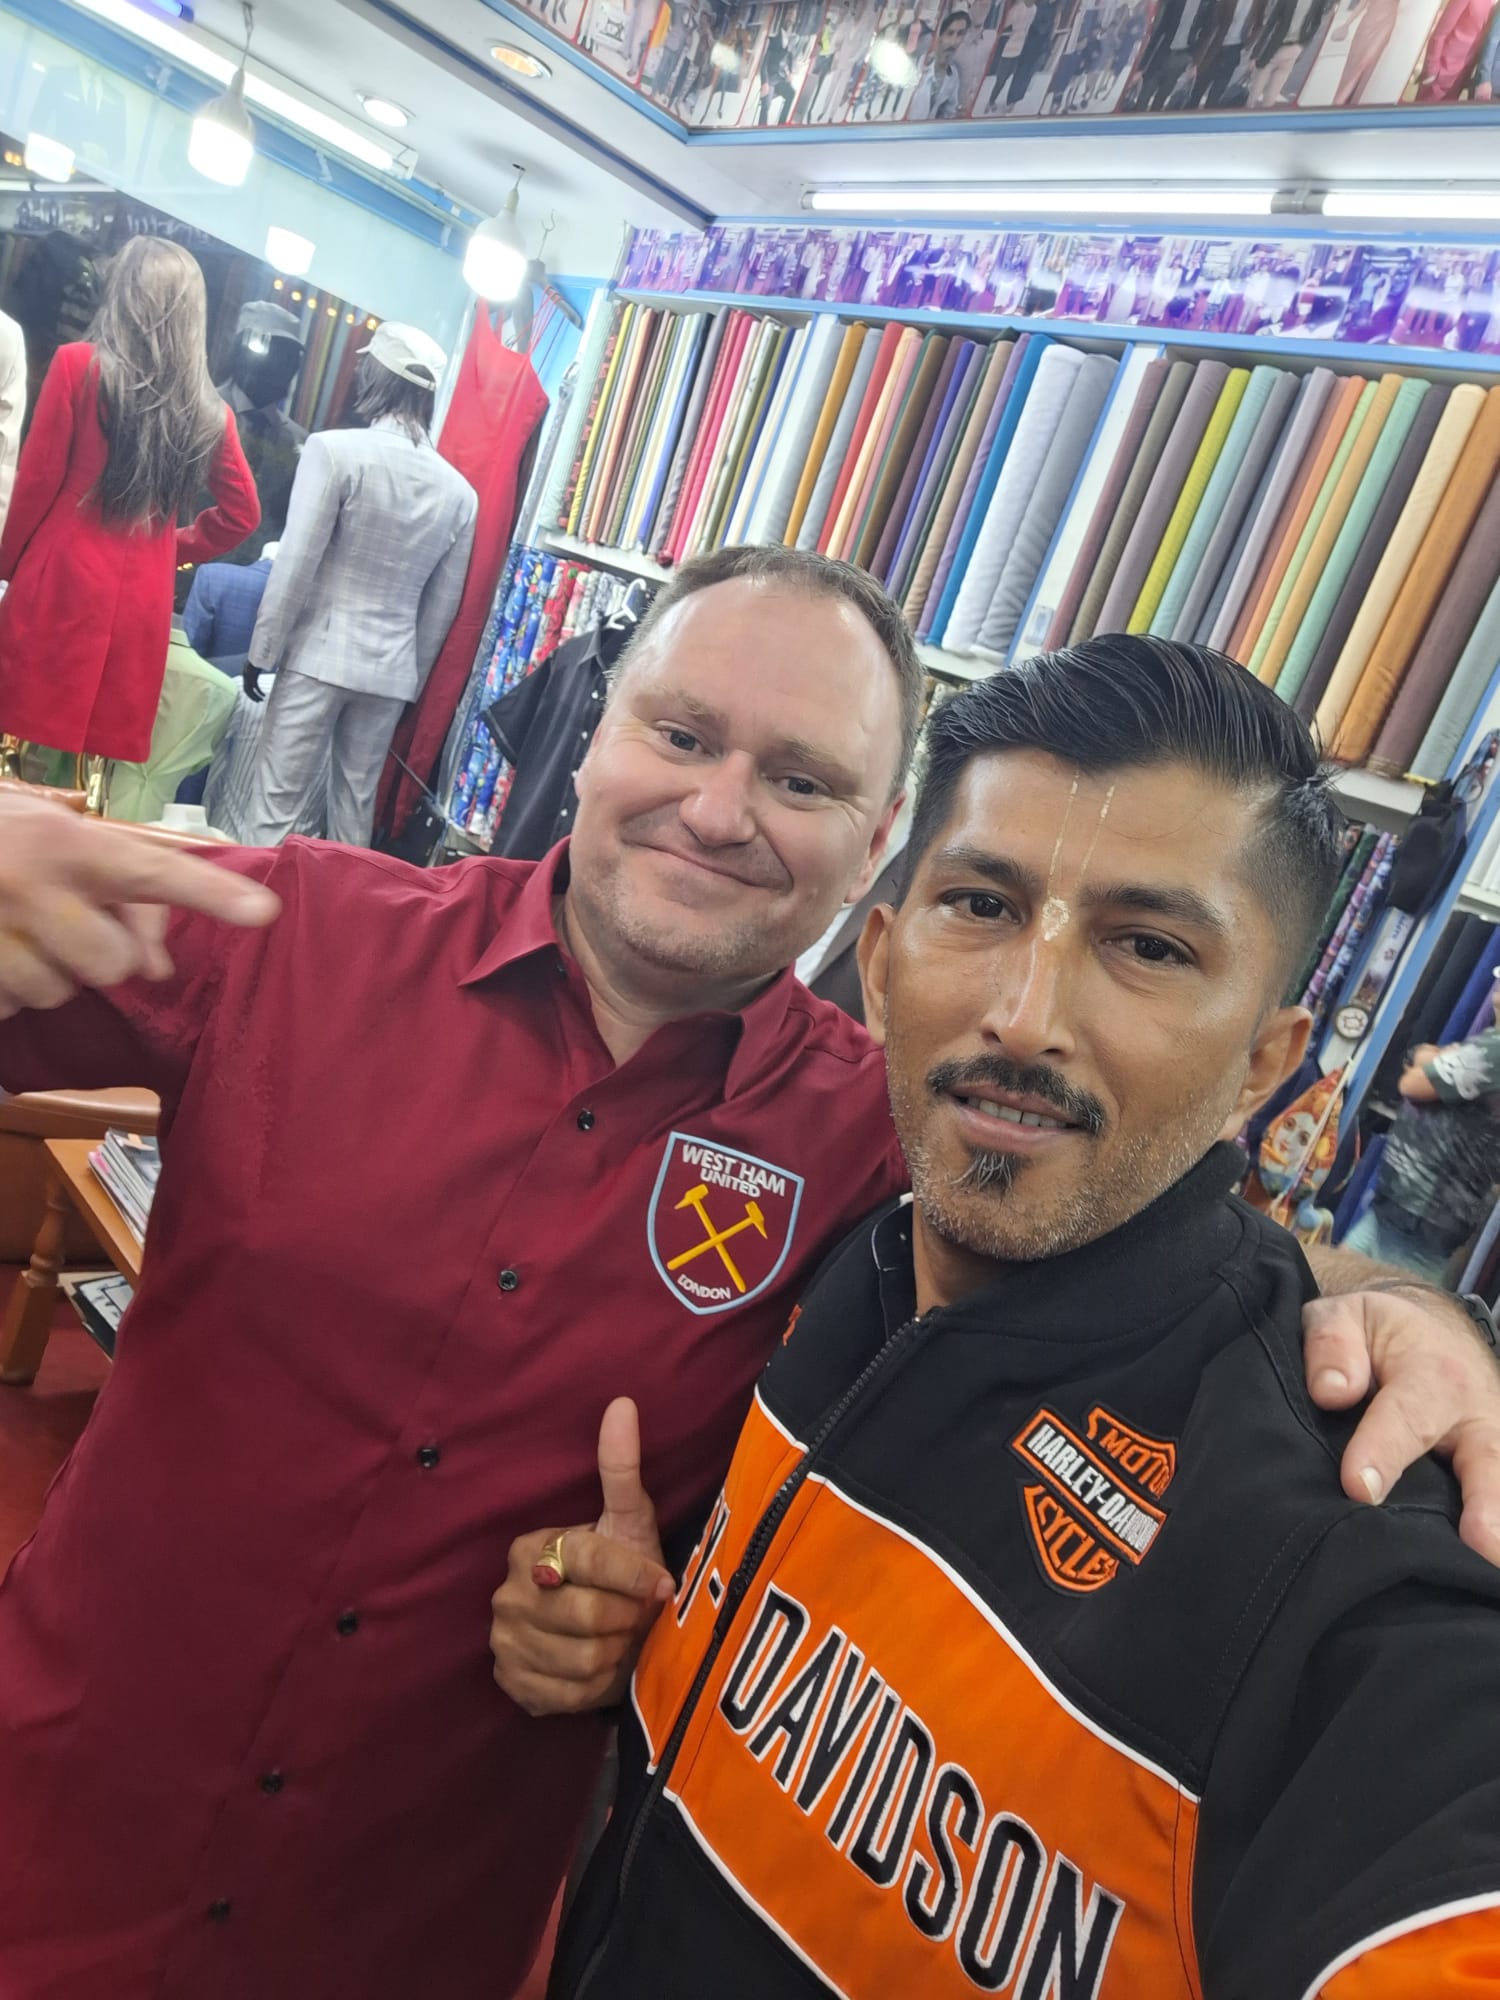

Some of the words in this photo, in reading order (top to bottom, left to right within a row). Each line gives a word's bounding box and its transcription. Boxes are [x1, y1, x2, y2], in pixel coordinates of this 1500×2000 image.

[682, 1143, 737, 1173] WEST
[739, 1162, 786, 1197] HAM
[700, 1167, 761, 1198] UNITED
[677, 1274, 731, 1300] LONDON
[1026, 1423, 1160, 1554] HARLEY-DA
[718, 1581, 1126, 2000] DAVIDSON
